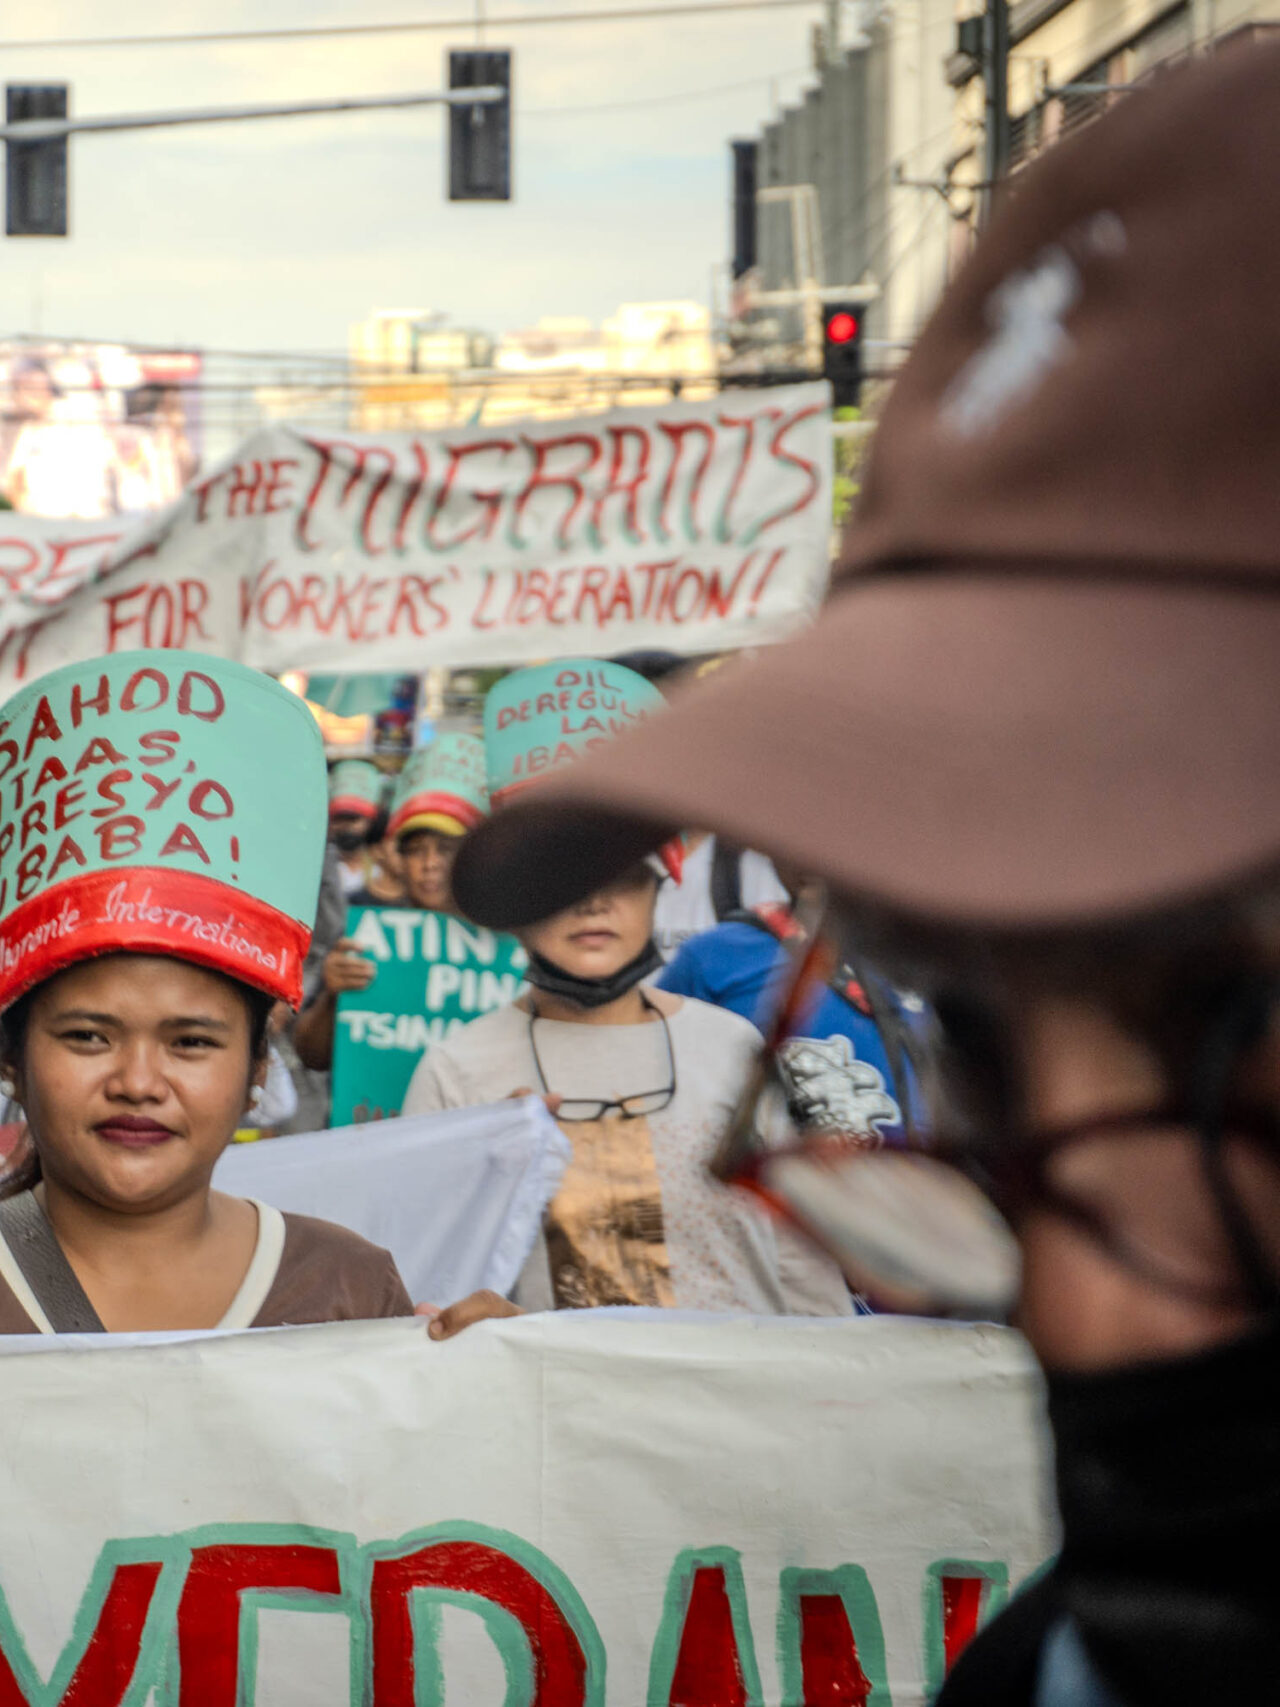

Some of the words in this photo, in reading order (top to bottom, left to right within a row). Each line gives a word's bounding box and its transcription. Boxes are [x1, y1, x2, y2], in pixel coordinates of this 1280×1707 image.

[193, 456, 299, 523] THE
[295, 403, 826, 556] MIGRANTS
[103, 578, 214, 653] FOR
[471, 547, 787, 629] LIBERATION!
[554, 669, 623, 692] OIL
[97, 880, 287, 978] International
[347, 909, 496, 967] ATIN
